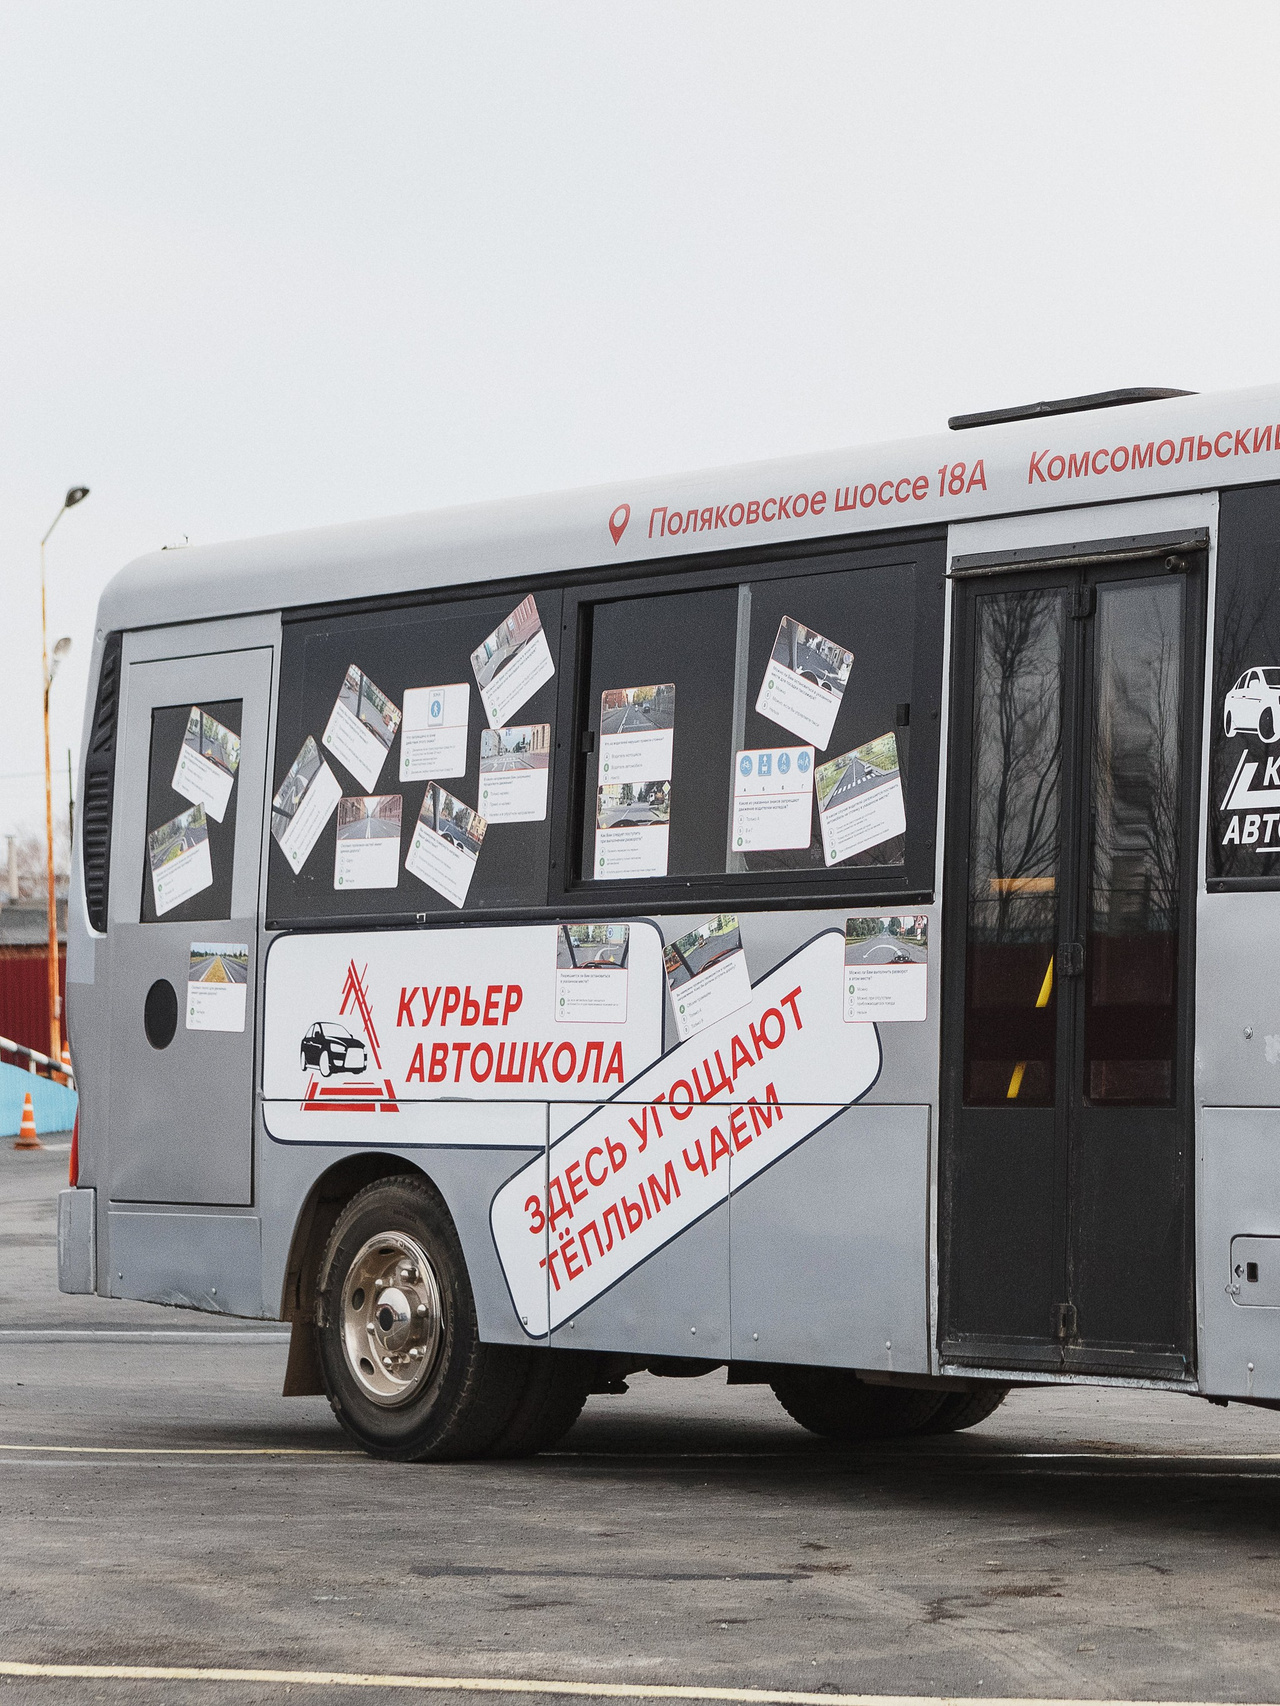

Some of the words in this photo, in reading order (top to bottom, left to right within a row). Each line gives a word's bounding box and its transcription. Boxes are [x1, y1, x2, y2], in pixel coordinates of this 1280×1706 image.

[649, 491, 826, 537] Поляковское
[835, 476, 928, 511] шоссе
[939, 460, 986, 496] 18А
[397, 985, 522, 1027] КУРЬЕР
[406, 1041, 624, 1083] АВТОШКОЛА
[525, 1137, 627, 1234] ЗДЕСЬ
[628, 986, 802, 1153] УГОЩАЮТ
[540, 1161, 680, 1290] ТЁПЛЫМ
[682, 1083, 783, 1177] ЧАЕМ
